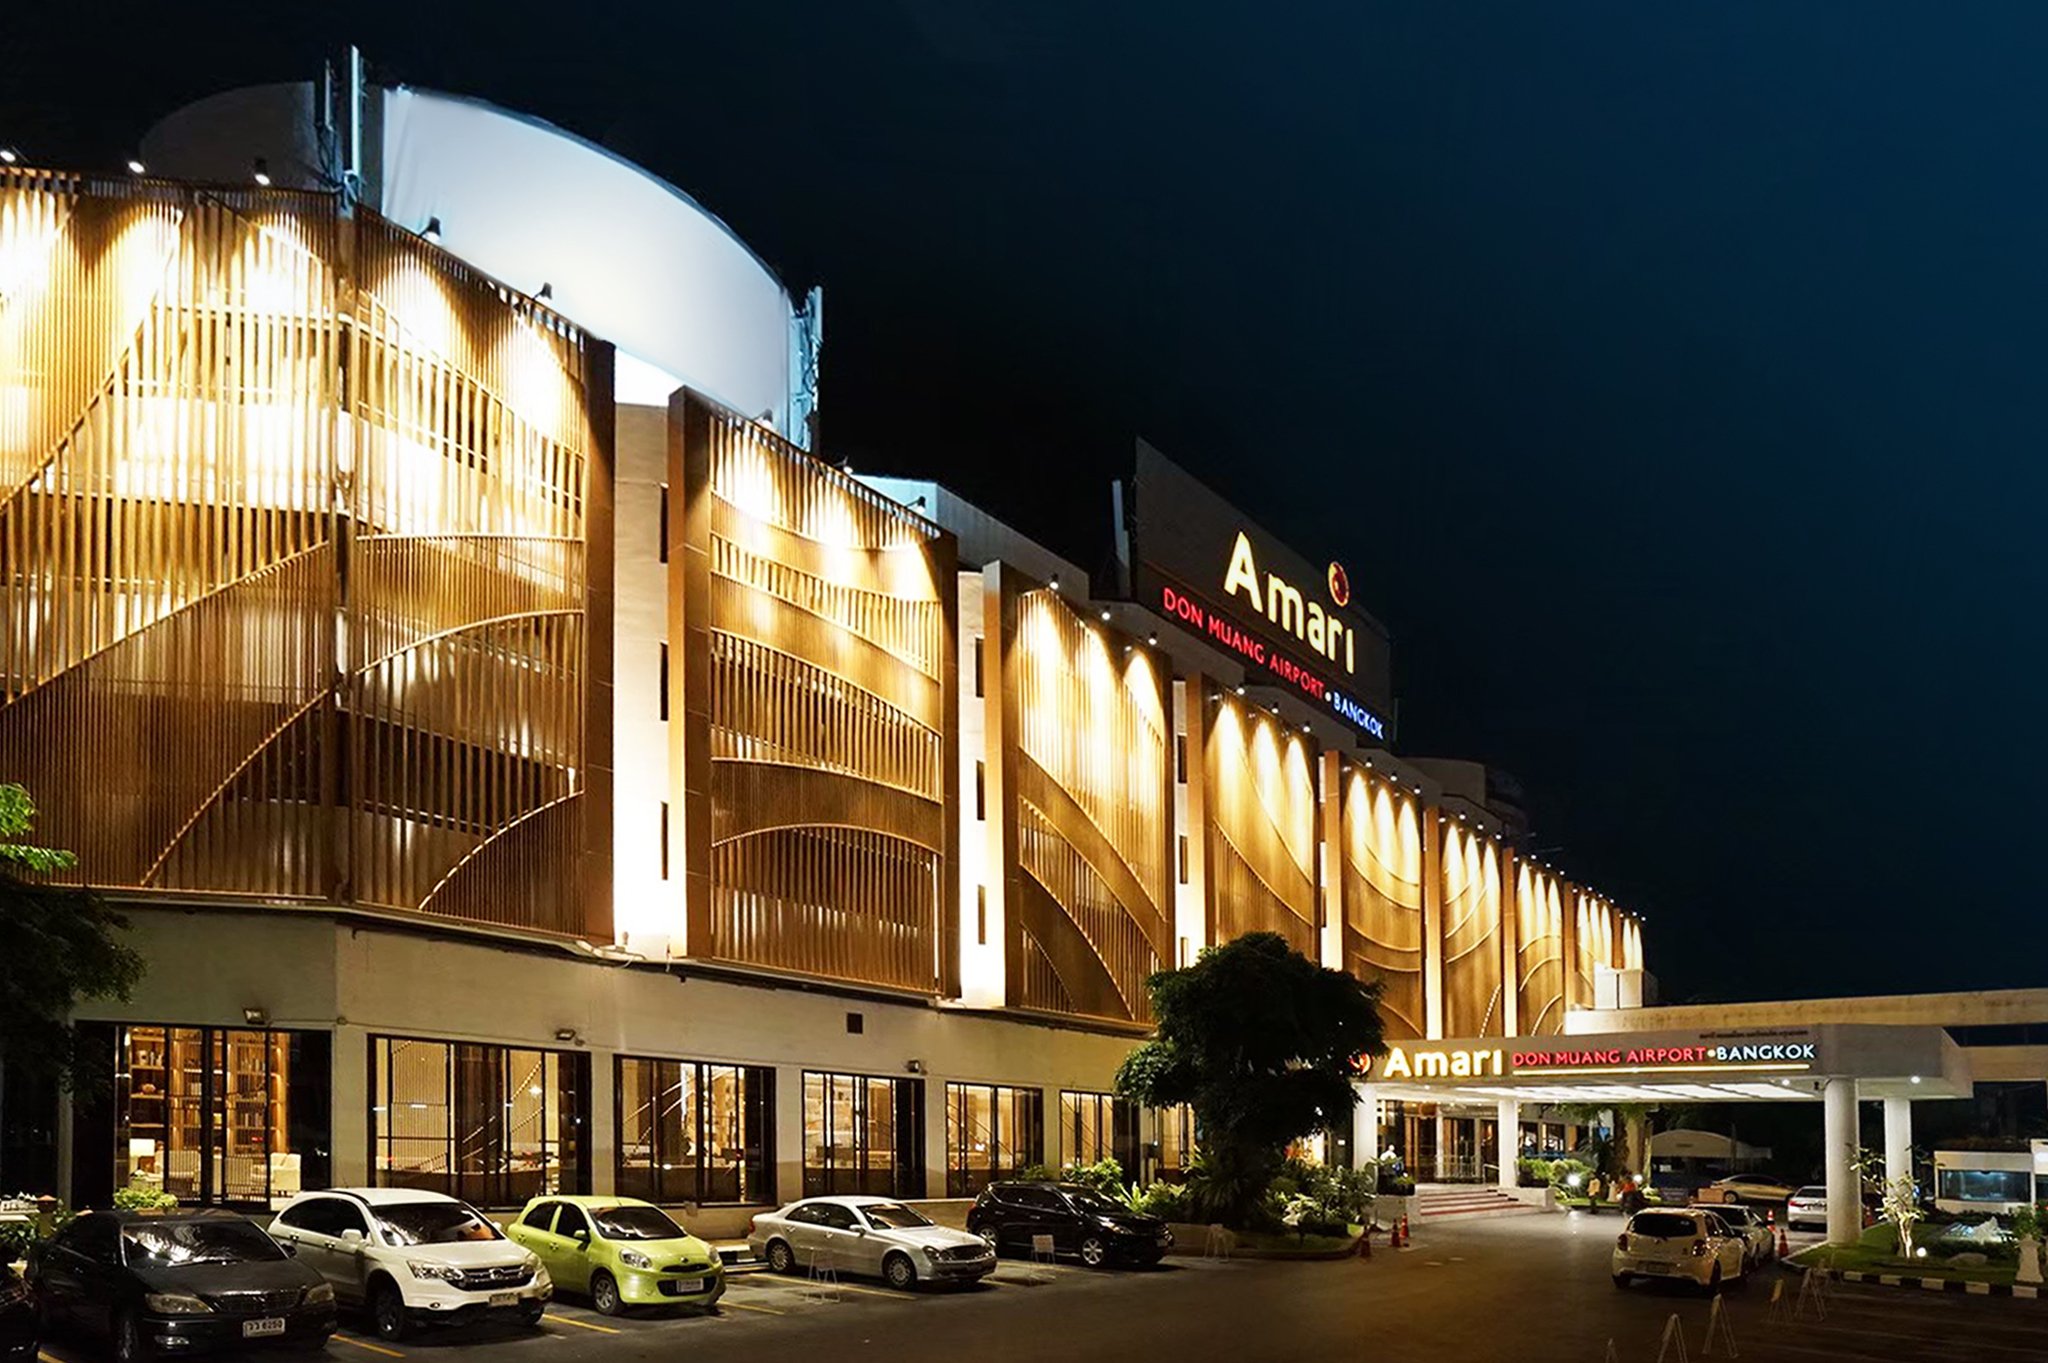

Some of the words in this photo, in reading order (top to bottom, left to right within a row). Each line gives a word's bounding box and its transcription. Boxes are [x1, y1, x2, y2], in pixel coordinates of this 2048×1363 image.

[1163, 587, 1203, 629] DON
[1208, 614, 1265, 665] MUANG
[1269, 653, 1325, 699] AIRPORT
[1333, 690, 1384, 740] BANGKOK
[1223, 530, 1355, 675] Amari
[1383, 1046, 1503, 1078] Amari
[1512, 1051, 1552, 1067] DON
[1555, 1049, 1621, 1065] MUANG
[1626, 1046, 1707, 1063] AIRPORT
[1716, 1043, 1816, 1061] BANGKOK
